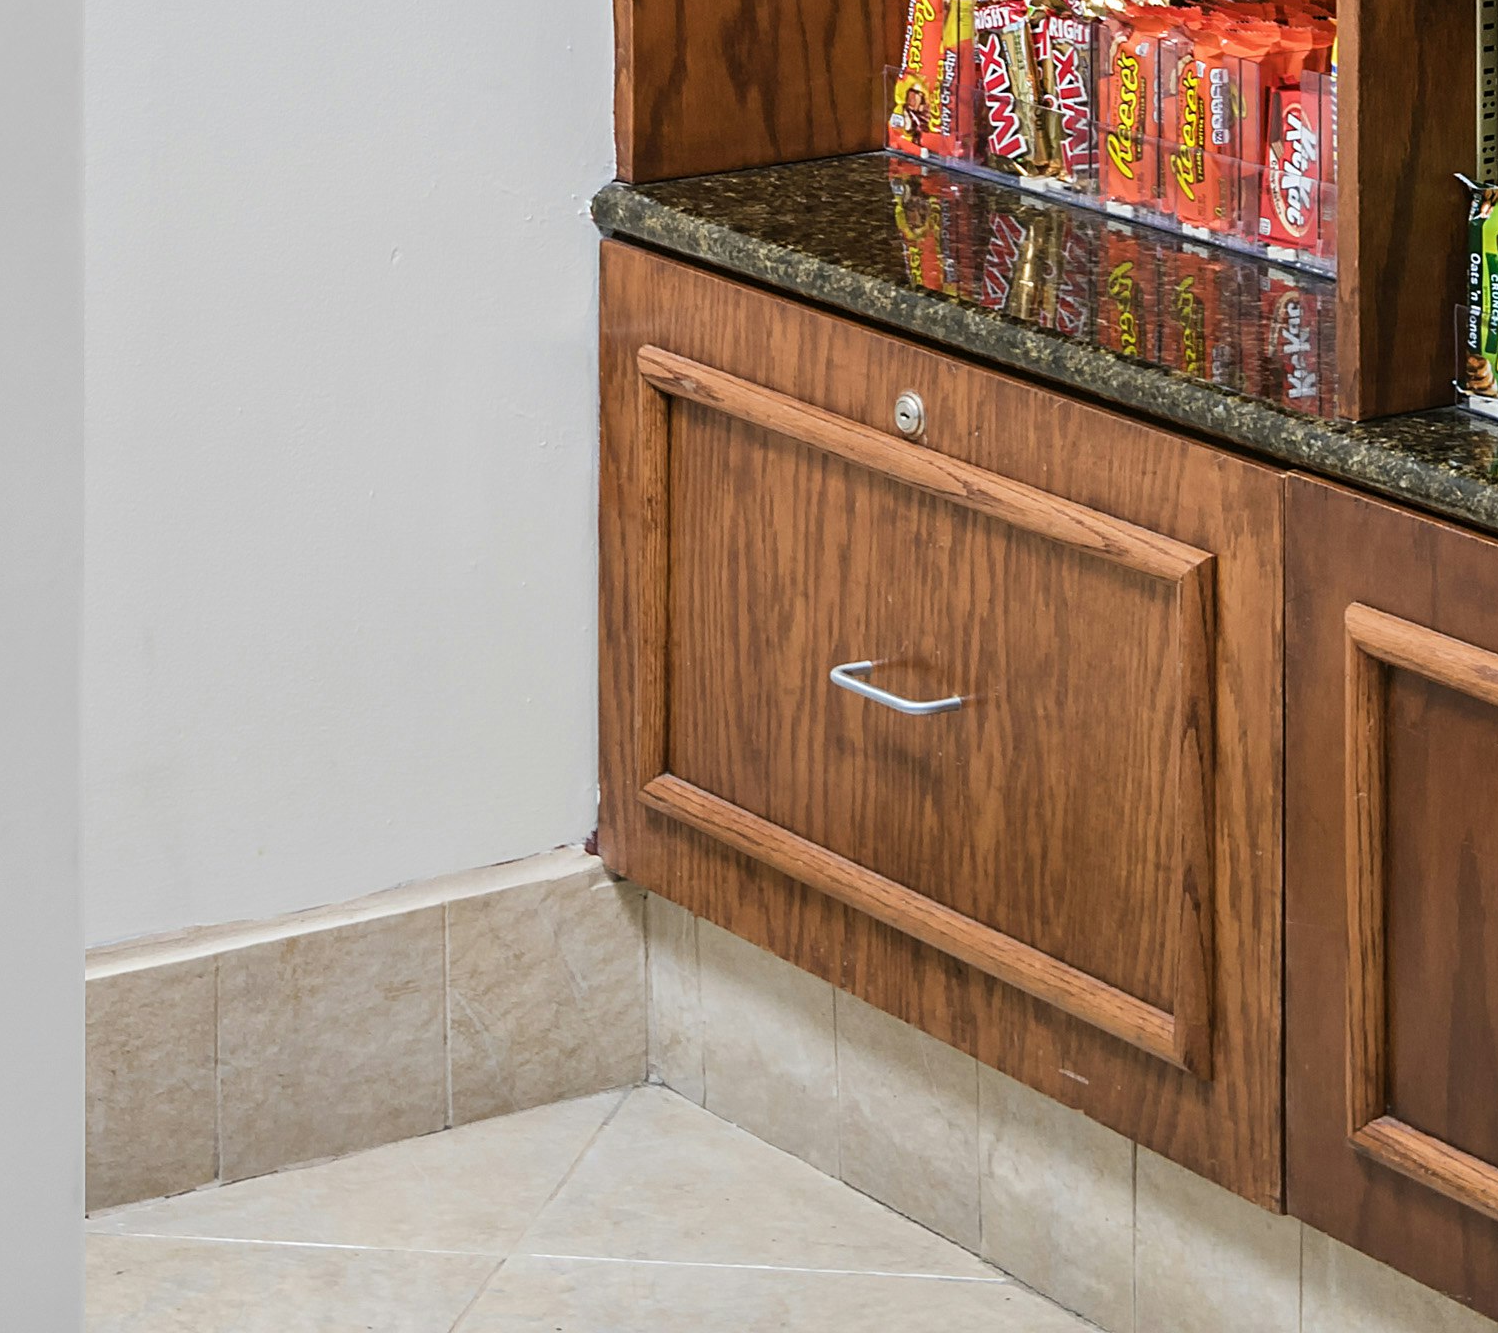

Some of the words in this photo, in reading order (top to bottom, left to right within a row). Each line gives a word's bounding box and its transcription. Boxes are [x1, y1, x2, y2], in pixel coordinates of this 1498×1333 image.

[980, 34, 1028, 159] TWIX
[1107, 51, 1139, 180] Reese's
[1170, 70, 1200, 202] Reese's
